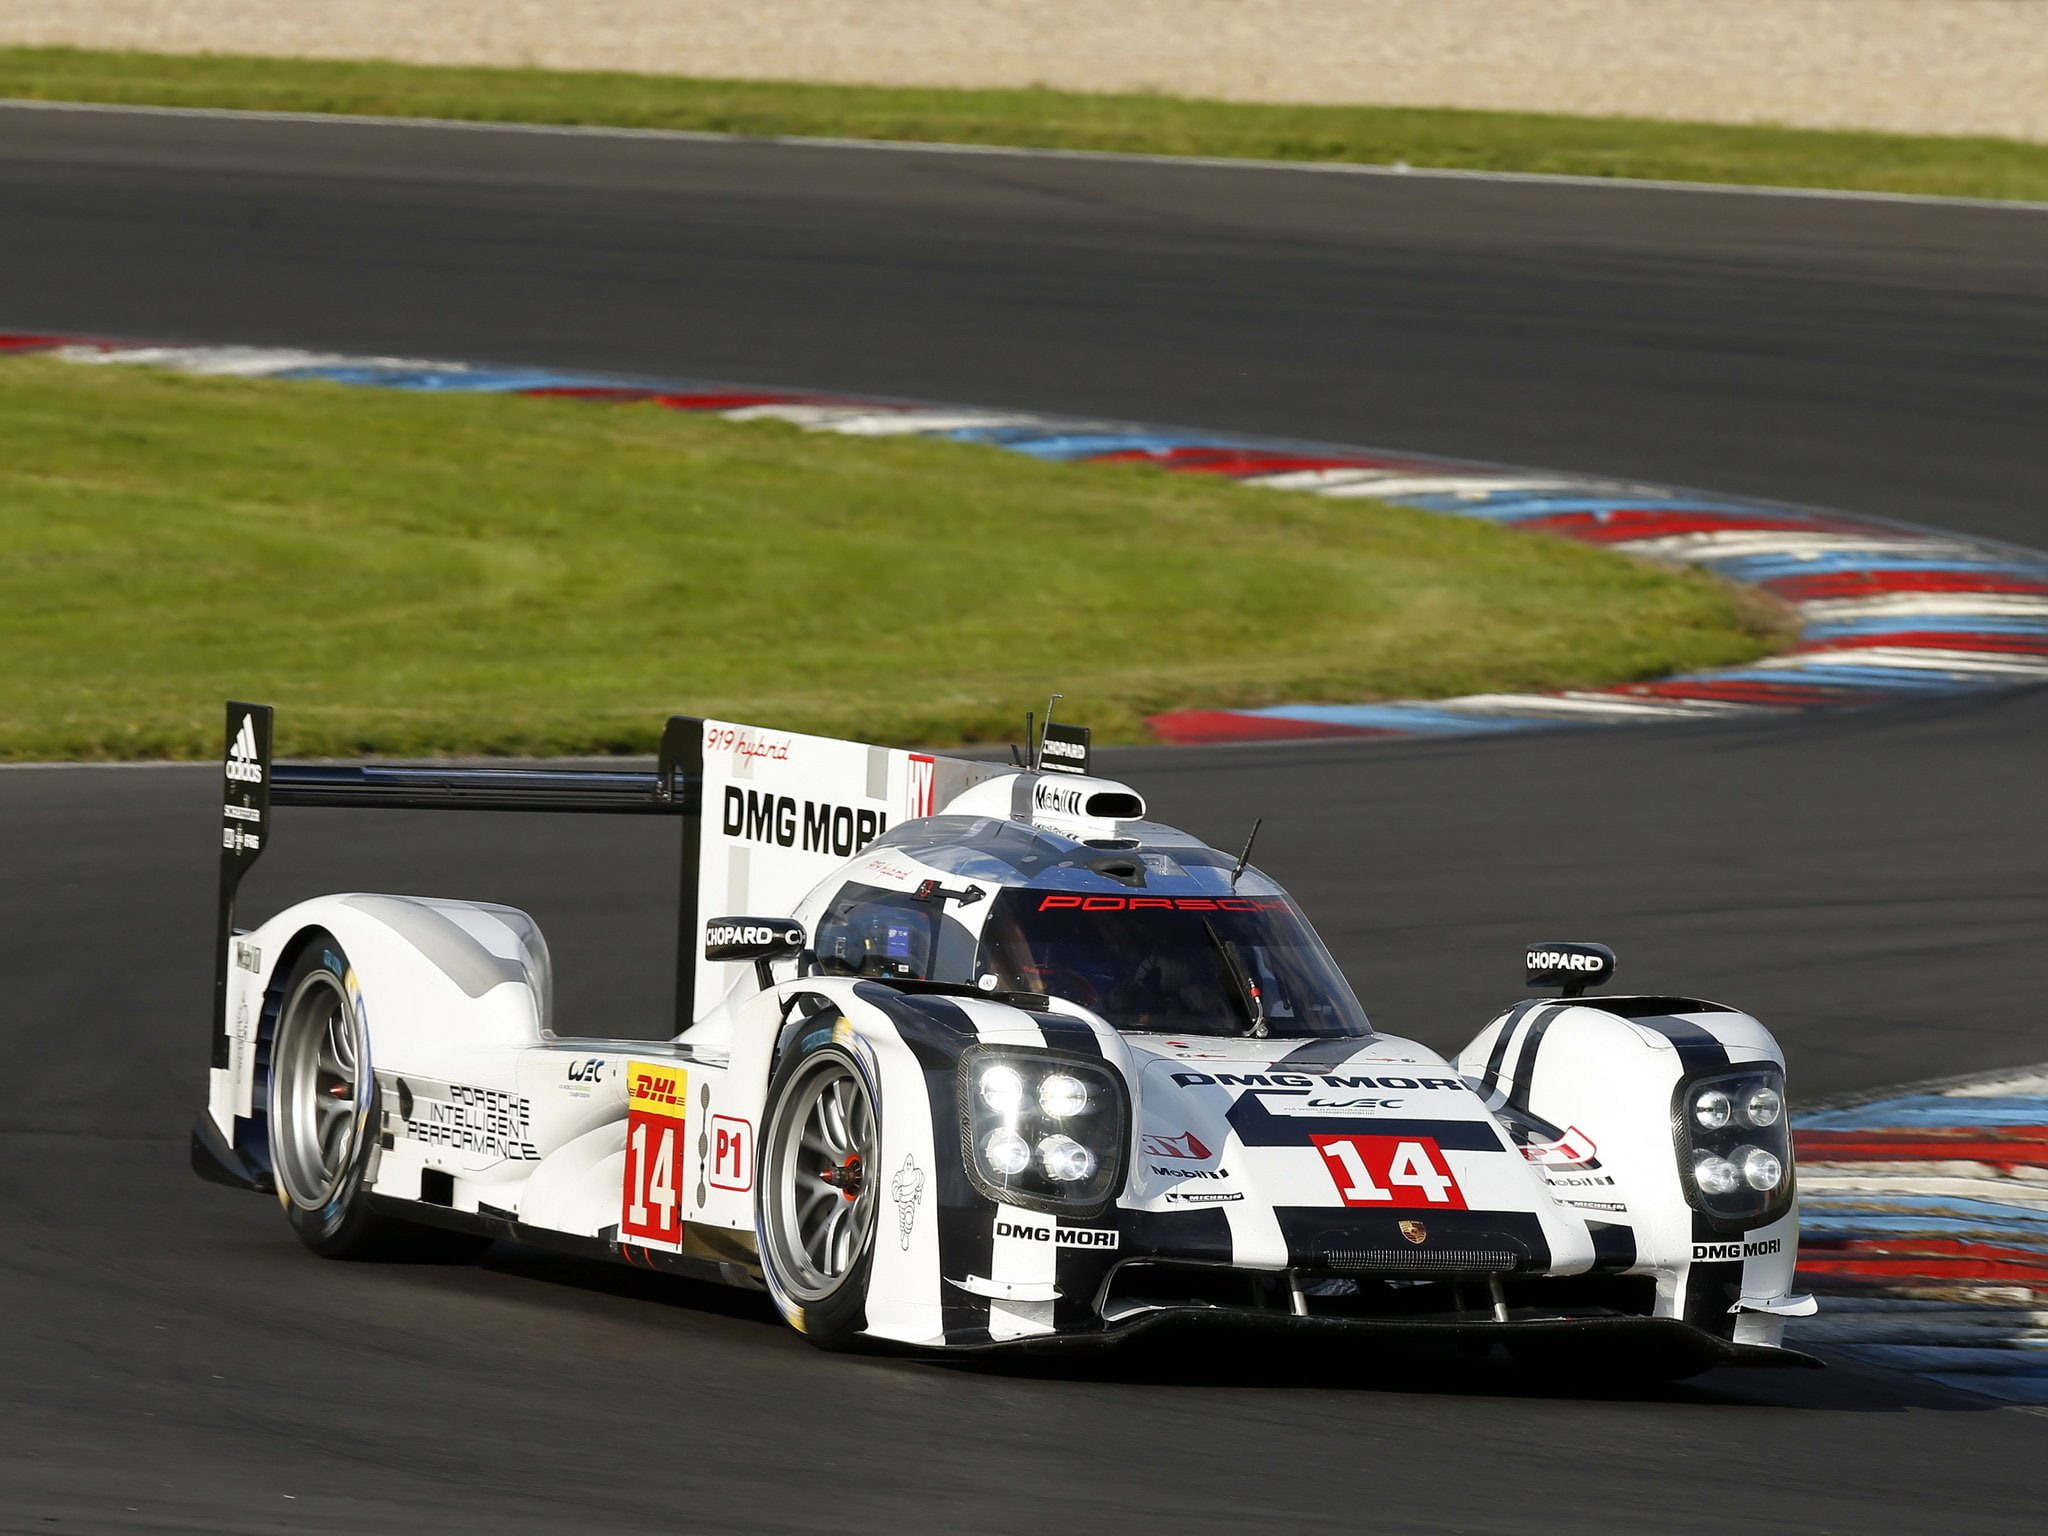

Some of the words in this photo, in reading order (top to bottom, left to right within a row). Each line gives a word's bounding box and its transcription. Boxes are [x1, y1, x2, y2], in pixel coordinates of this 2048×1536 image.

[706, 728, 735, 750] 919
[733, 732, 792, 769] hybrid
[225, 757, 262, 783] adidas
[907, 758, 934, 820] HY
[1036, 784, 1069, 814] Mobil
[723, 785, 797, 848] DMG
[1038, 896, 1292, 914] PORSCH
[707, 926, 773, 946] CHOPARD
[1526, 952, 1603, 971] CHOPARD
[568, 1058, 605, 1083] WEC
[1171, 1073, 1313, 1088] DMG
[450, 1085, 529, 1119] PORSCHE
[636, 1075, 677, 1105] DHL
[1307, 1098, 1404, 1109] WEC
[430, 1103, 529, 1140] INTELLIGENT
[407, 1120, 541, 1160] PERFORMANCE
[715, 1128, 741, 1178] P1
[629, 1123, 676, 1231] 14
[1151, 1165, 1208, 1179] Mobil
[1322, 1140, 1453, 1203] 14
[1189, 1193, 1242, 1201] MICHELIN
[1573, 1201, 1625, 1210] MICHELIN
[996, 1222, 1050, 1241] DMG
[1055, 1229, 1116, 1246] MORI
[1692, 1244, 1741, 1259] DMG
[1743, 1238, 1780, 1257] MORI
